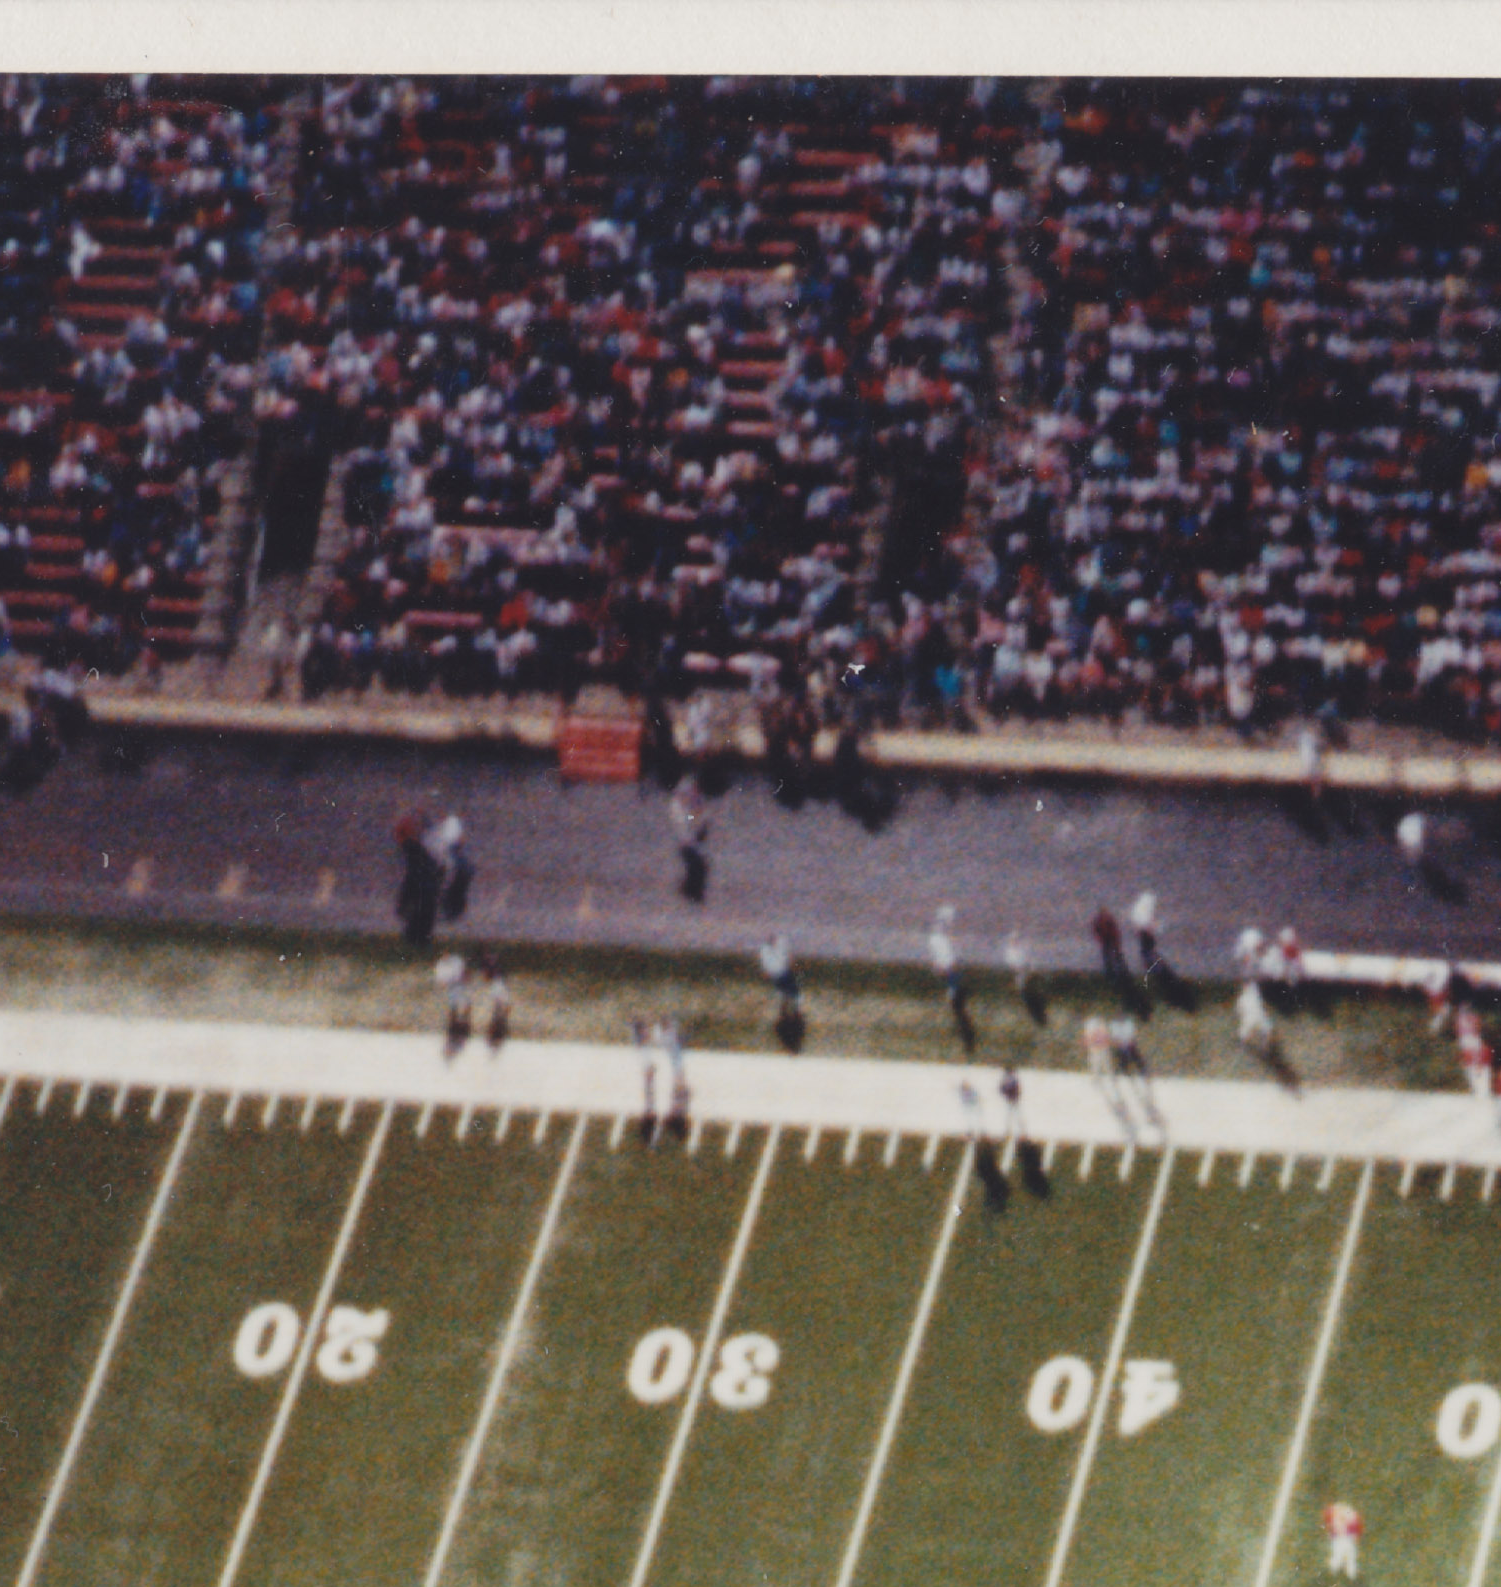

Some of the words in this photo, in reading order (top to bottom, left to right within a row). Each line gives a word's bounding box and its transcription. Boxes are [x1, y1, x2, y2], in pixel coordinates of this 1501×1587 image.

[233, 1299, 388, 1382] 20
[627, 1326, 780, 1411] 30
[1025, 1353, 1180, 1437] 40
